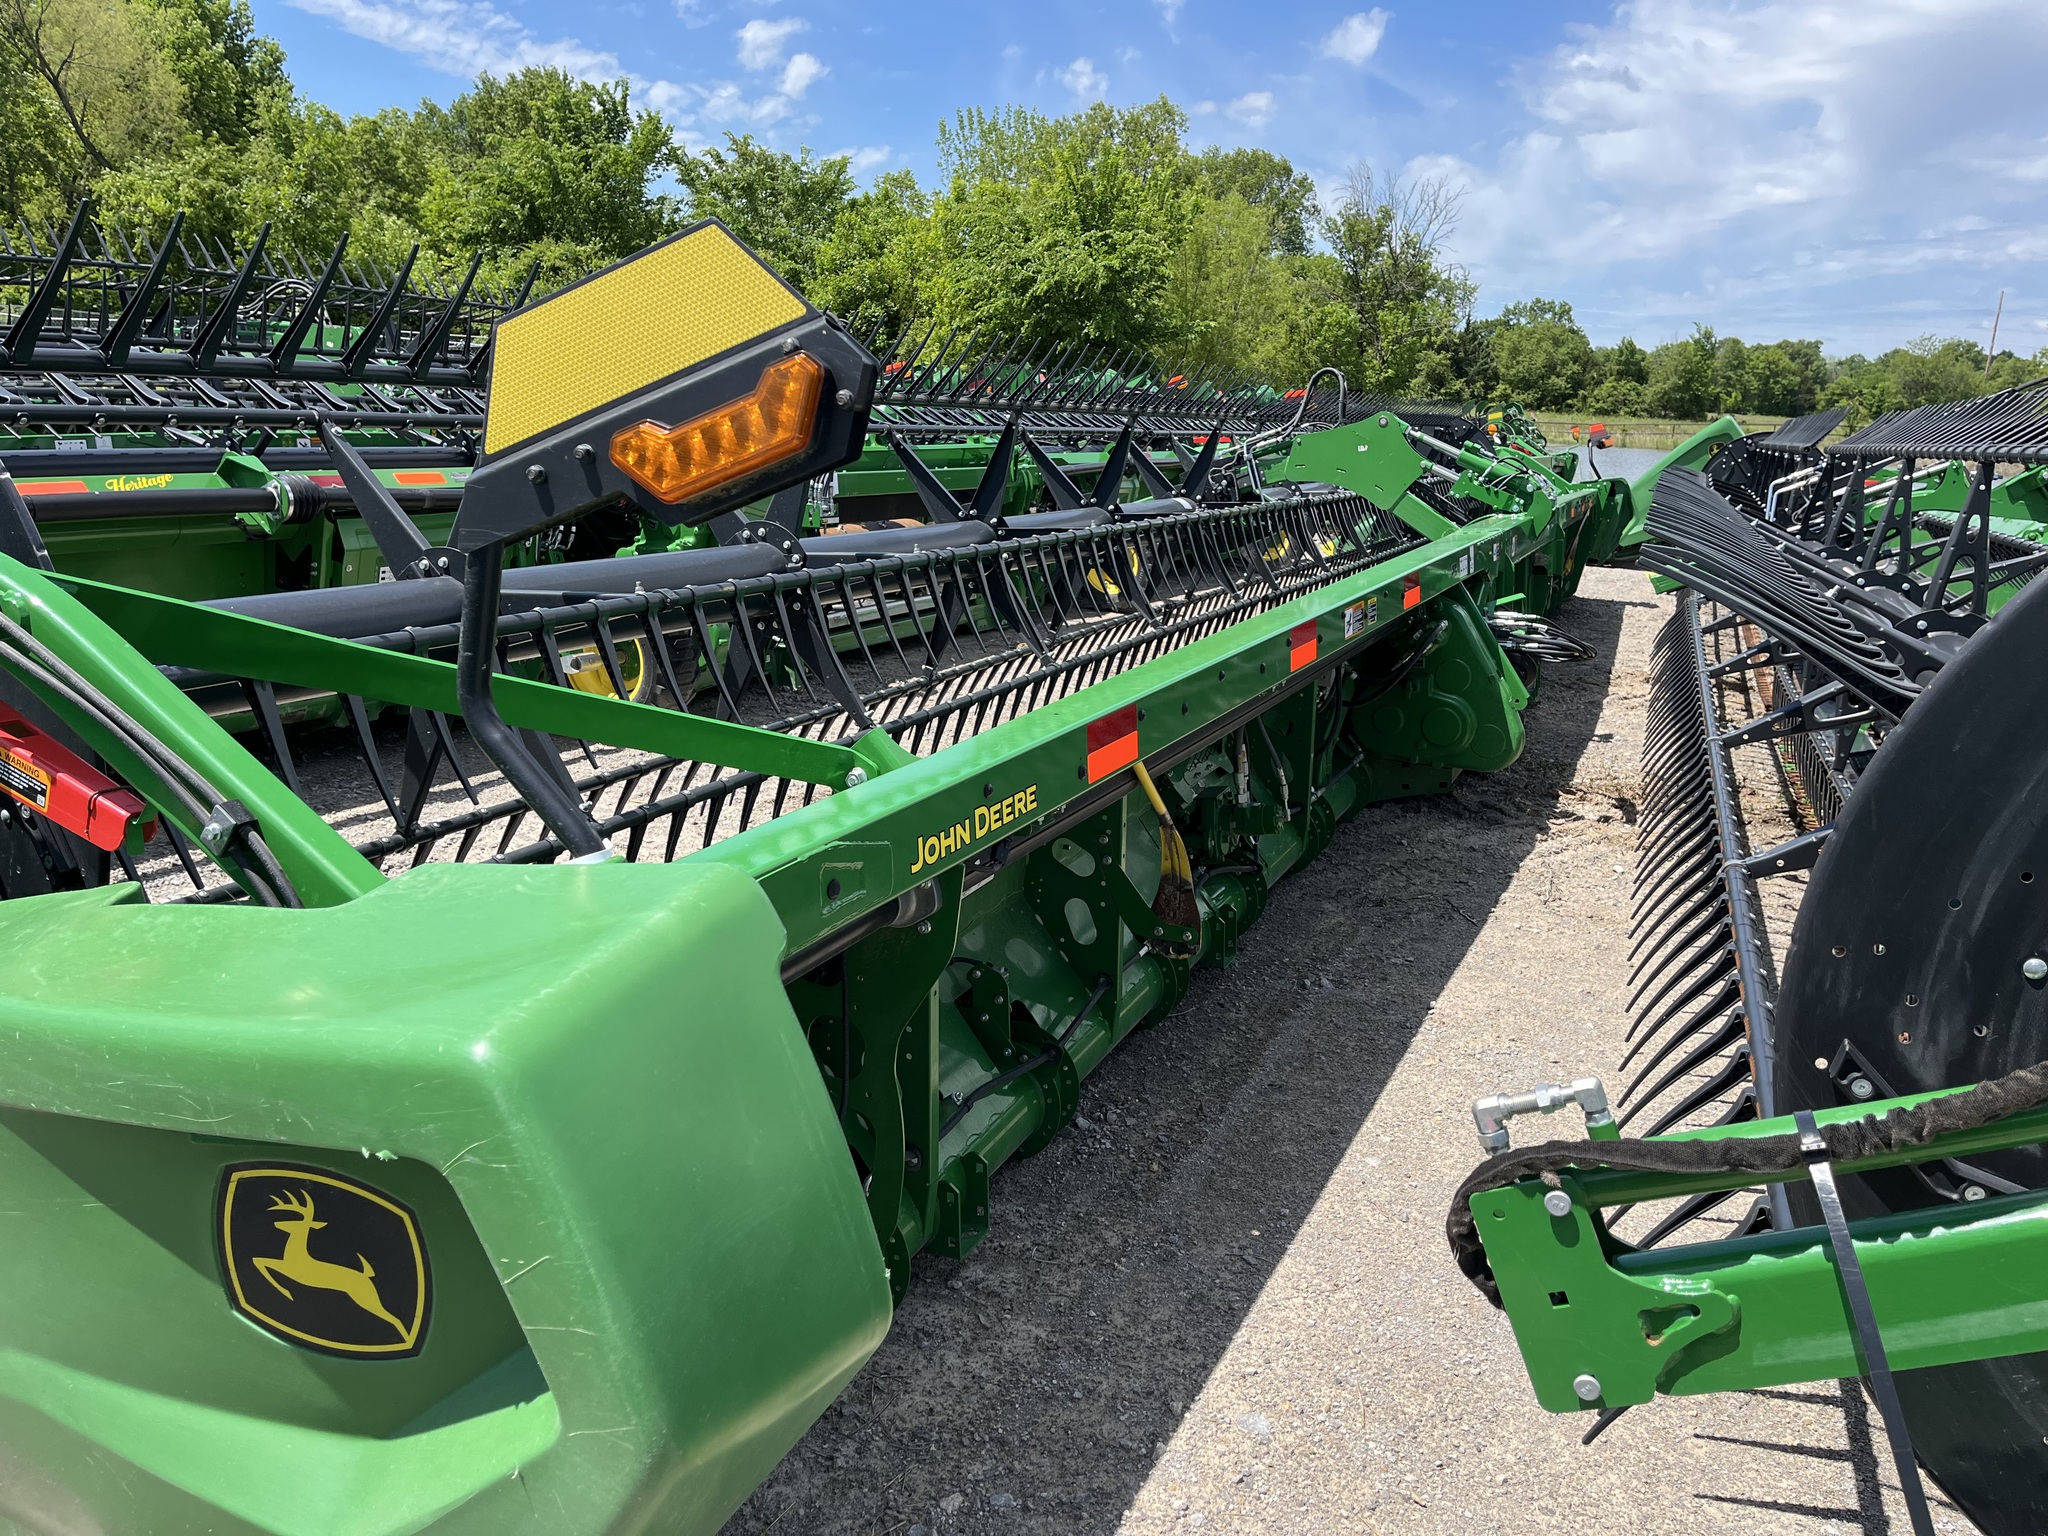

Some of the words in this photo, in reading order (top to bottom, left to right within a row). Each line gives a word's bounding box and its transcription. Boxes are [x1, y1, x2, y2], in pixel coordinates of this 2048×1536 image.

[105, 474, 174, 491] Heritage
[5, 751, 40, 778] WARNING
[911, 817, 971, 874] JOHN
[974, 783, 1038, 840] DEERE
